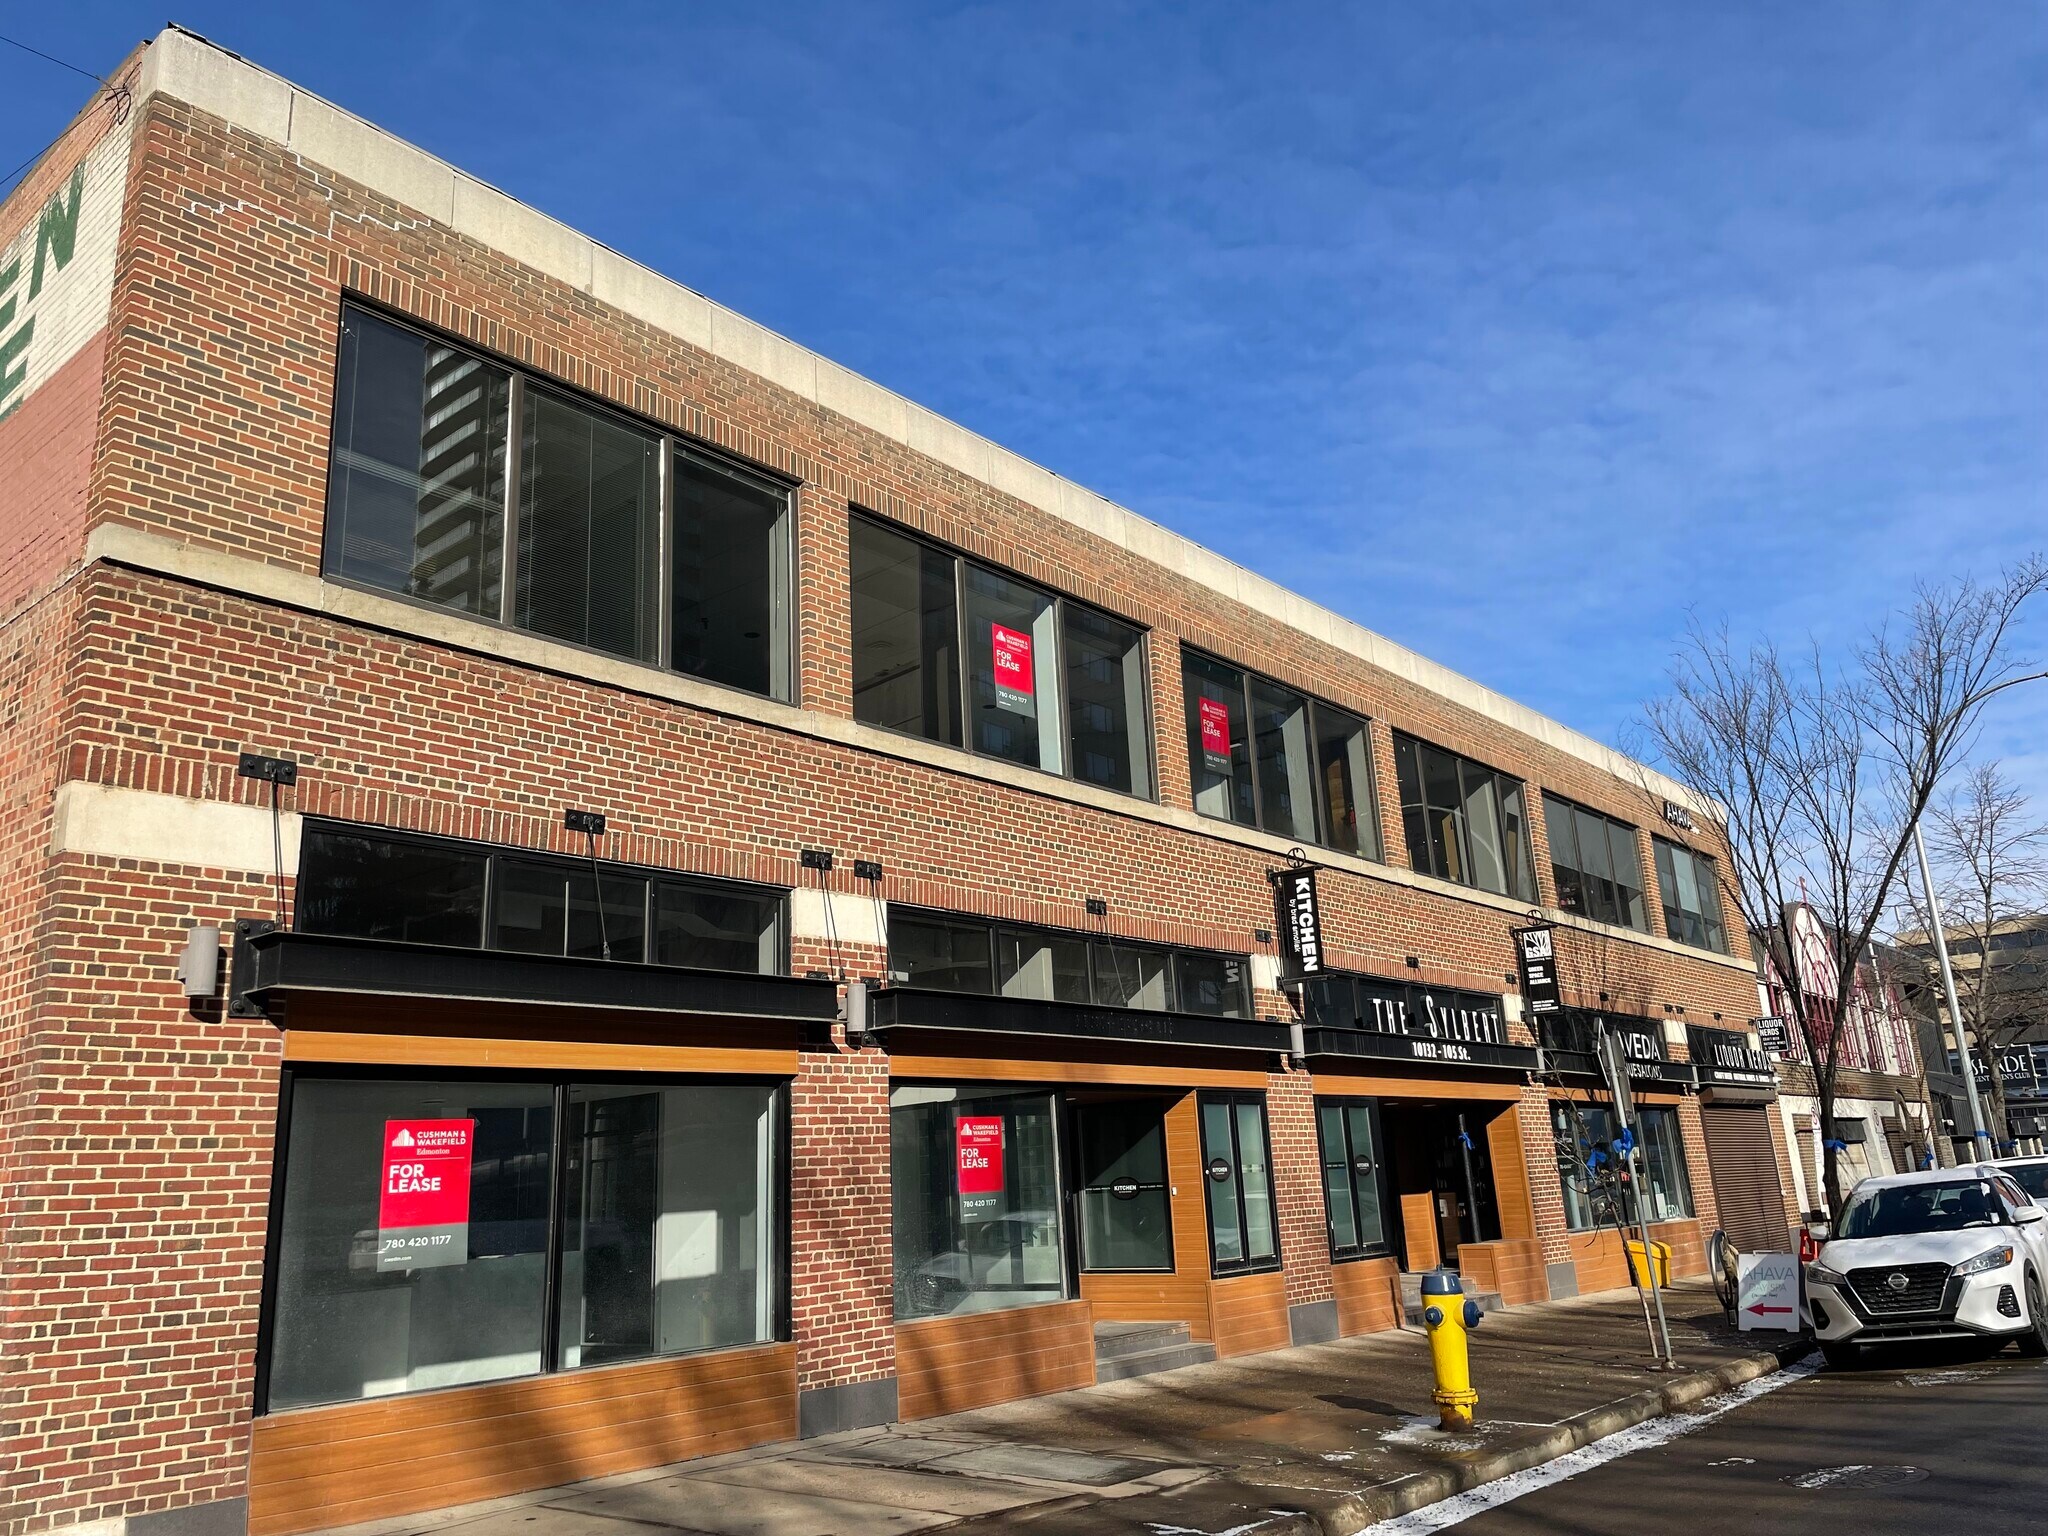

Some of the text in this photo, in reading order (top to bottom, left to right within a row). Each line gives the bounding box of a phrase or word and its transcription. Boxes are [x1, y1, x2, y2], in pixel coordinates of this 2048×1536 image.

[1006, 639, 1029, 650] WAKEFIELD
[996, 649, 1012, 661] FOR
[996, 658, 1020, 672] LEASE
[1203, 719, 1215, 729] FOR
[1203, 726, 1221, 738] LEASE
[1666, 801, 1693, 829] AHAVA
[1288, 898, 1297, 908] by
[1290, 908, 1299, 925] brad
[1295, 877, 1319, 973] KITCHEN
[1372, 995, 1501, 1044] THE SYLBERT
[1757, 1018, 1784, 1029] LIQUOR
[1759, 1028, 1780, 1036] NERDS
[1412, 1042, 1437, 1058] 10132
[1443, 1044, 1458, 1059] 105
[1458, 1045, 1471, 1061] St.
[1714, 1044, 1774, 1072] LIQUOR NERDS
[417, 1131, 459, 1139] CUSHMAN
[417, 1138, 467, 1146] WAKEFIELD
[416, 1148, 450, 1156] Edmonton
[961, 1148, 979, 1158] FOR
[961, 1158, 989, 1169] LEASE
[389, 1163, 425, 1179] FOR
[388, 1177, 442, 1194] LEASE
[963, 1200, 974, 1208] 780
[385, 1235, 452, 1249] 780 420 1177
[1743, 1266, 1796, 1280] AHAVA
[1748, 1283, 1788, 1292] DAY SPA
